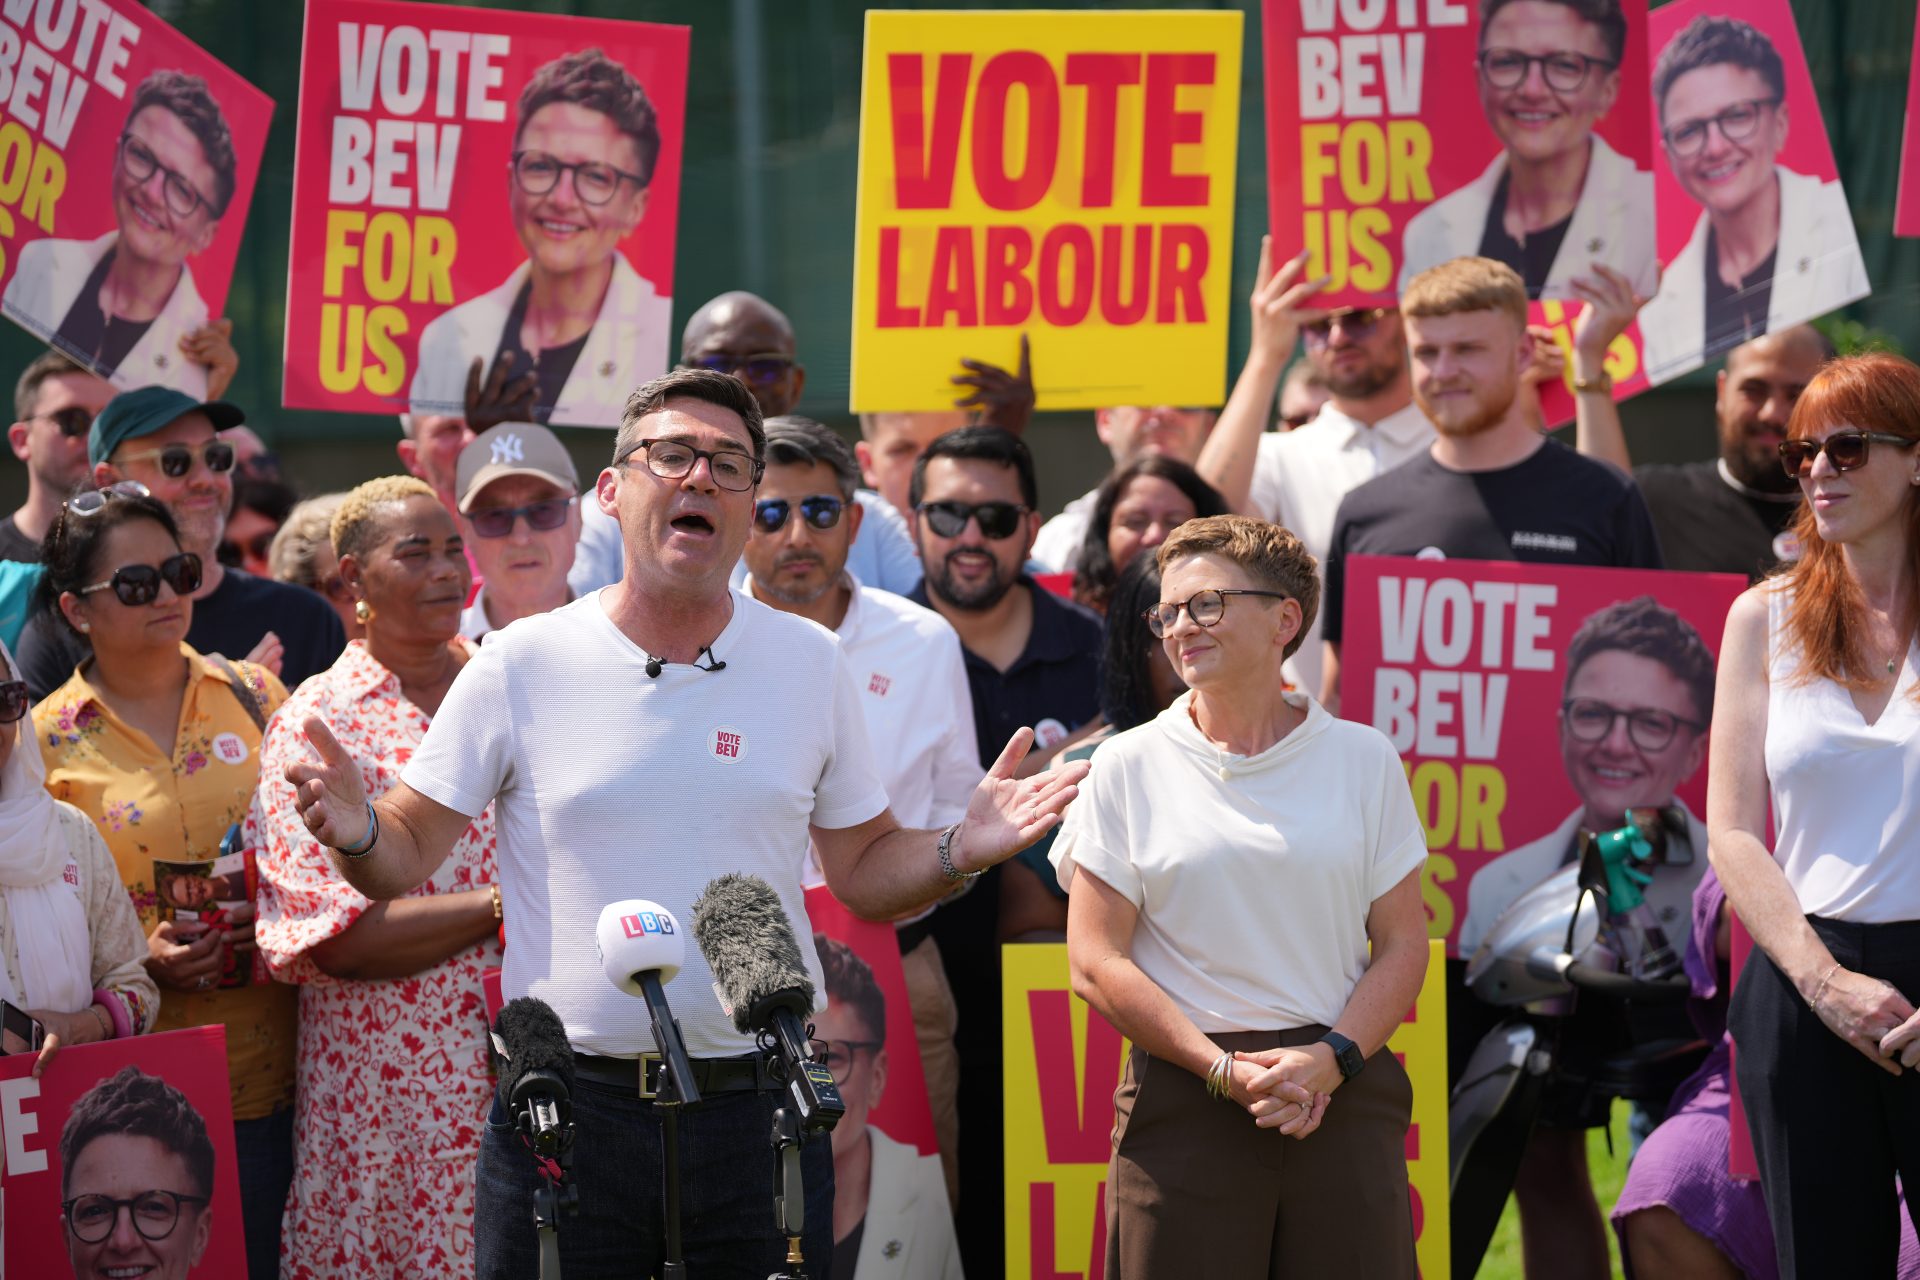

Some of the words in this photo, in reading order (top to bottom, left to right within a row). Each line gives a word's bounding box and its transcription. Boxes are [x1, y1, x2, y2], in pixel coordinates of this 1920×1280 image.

[338, 21, 511, 122] VOTE
[1297, 32, 1426, 120] BEV
[0, 115, 67, 235] OR
[328, 115, 462, 211] BEV
[887, 50, 1216, 211] VOTE
[1300, 120, 1435, 206] FOR
[322, 209, 457, 305] FOR
[876, 222, 1210, 328] LABOUR
[1303, 207, 1393, 294] US
[318, 303, 409, 396] US
[1378, 576, 1558, 672] VOTE
[715, 741, 739, 758] BEV
[717, 731, 741, 746] VOTE
[1373, 667, 1508, 760] BEV
[1401, 760, 1507, 852] OR
[621, 912, 674, 937] LBC
